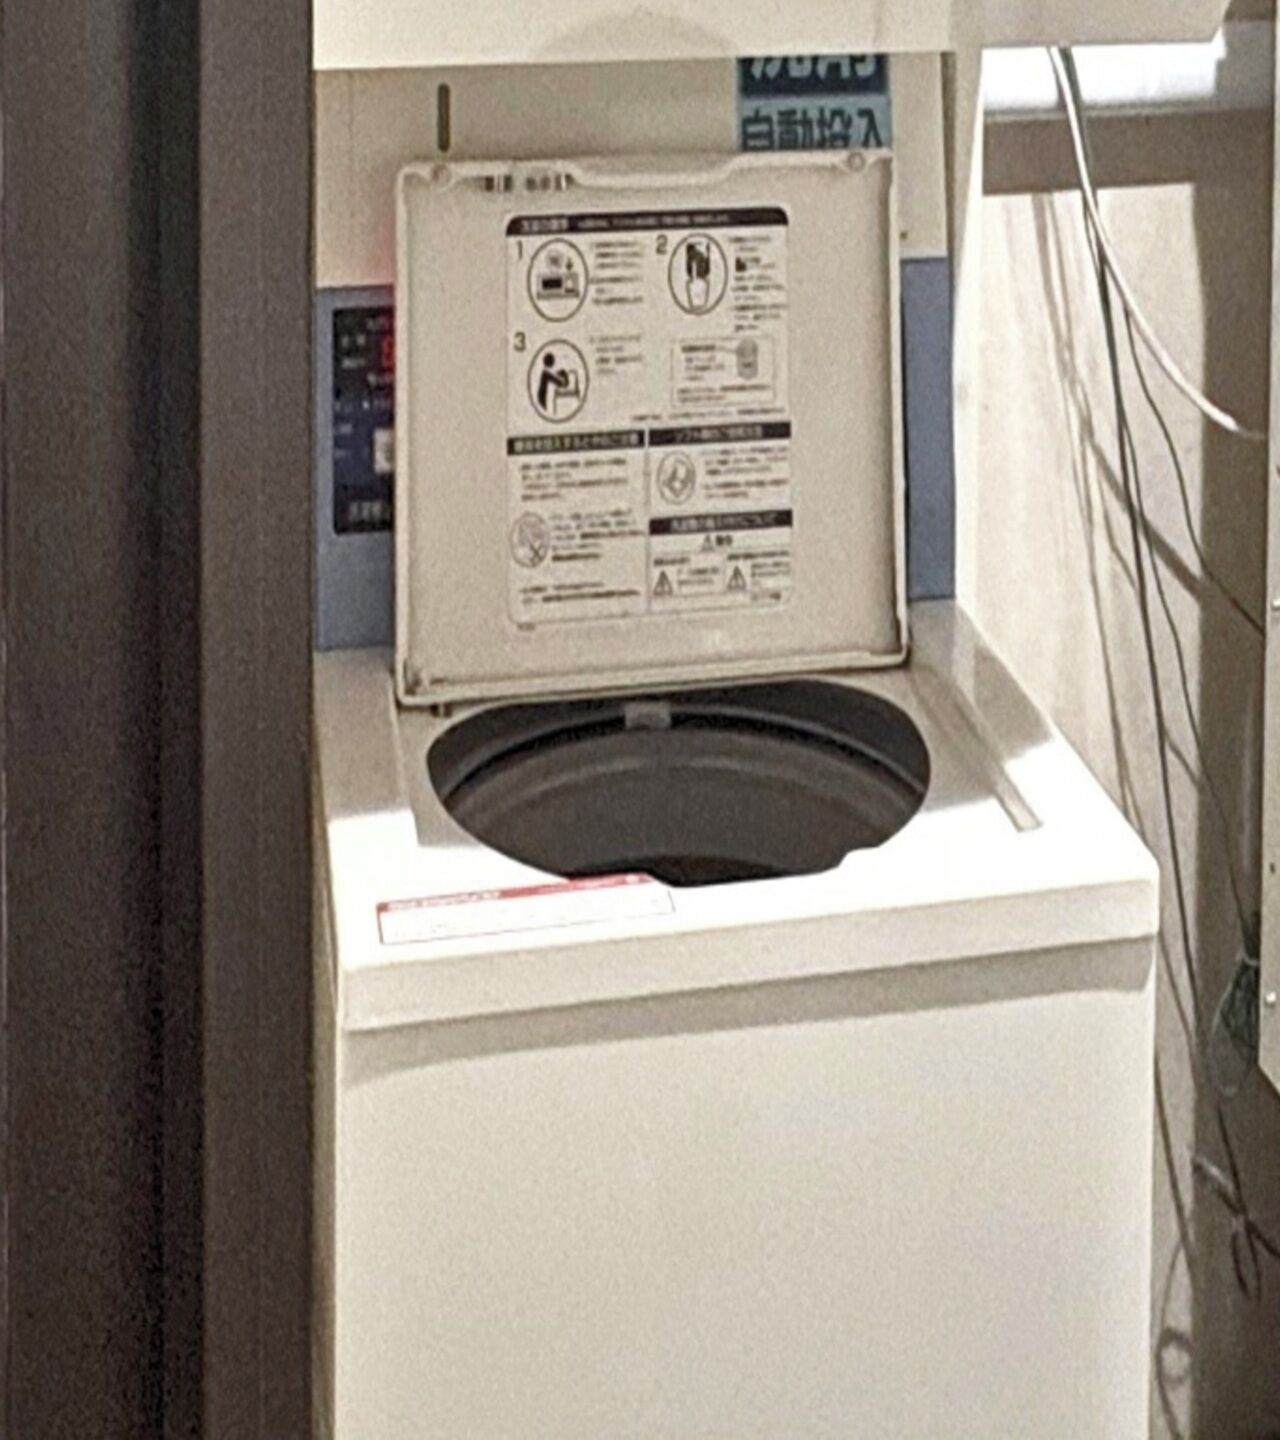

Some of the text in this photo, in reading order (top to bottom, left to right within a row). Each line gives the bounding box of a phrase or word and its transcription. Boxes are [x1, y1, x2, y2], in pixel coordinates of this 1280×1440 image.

[740, 108, 883, 153] 自動投入
[655, 235, 669, 255] 2
[513, 332, 526, 352] 3
